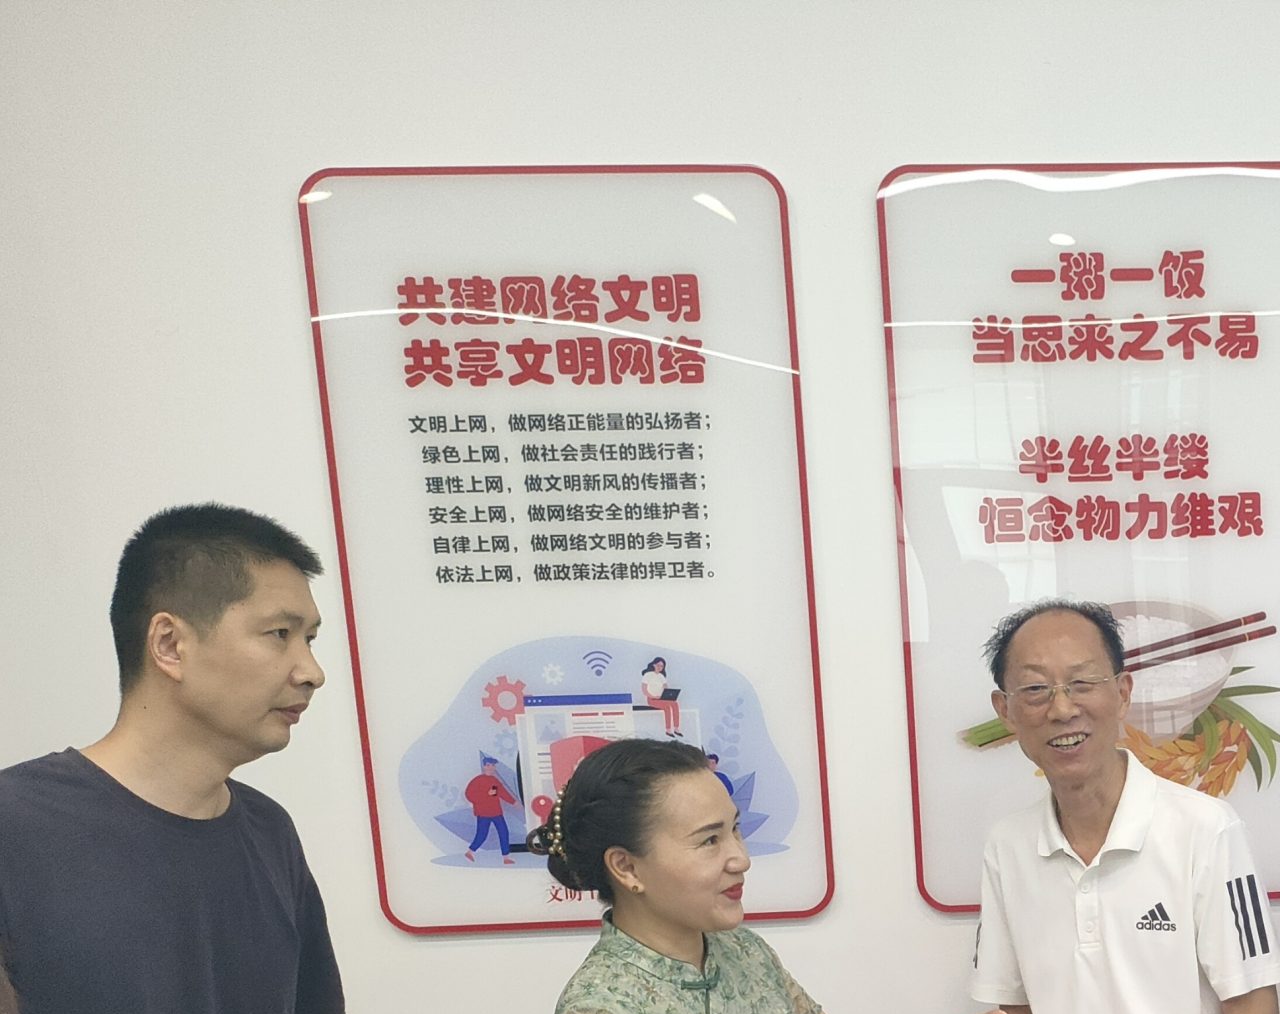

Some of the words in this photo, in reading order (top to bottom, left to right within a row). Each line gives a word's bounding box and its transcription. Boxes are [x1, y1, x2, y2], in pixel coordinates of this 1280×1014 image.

[398, 275, 701, 325] 共建网络文明
[1012, 251, 1205, 301] 一粥一饭
[404, 337, 704, 387] 共享文明网络
[973, 314, 1259, 363] 当思来之不易
[1020, 433, 1210, 484] 半丝半缕
[980, 491, 1264, 543] 恒念物力维艰
[1136, 919, 1177, 932] adidas
